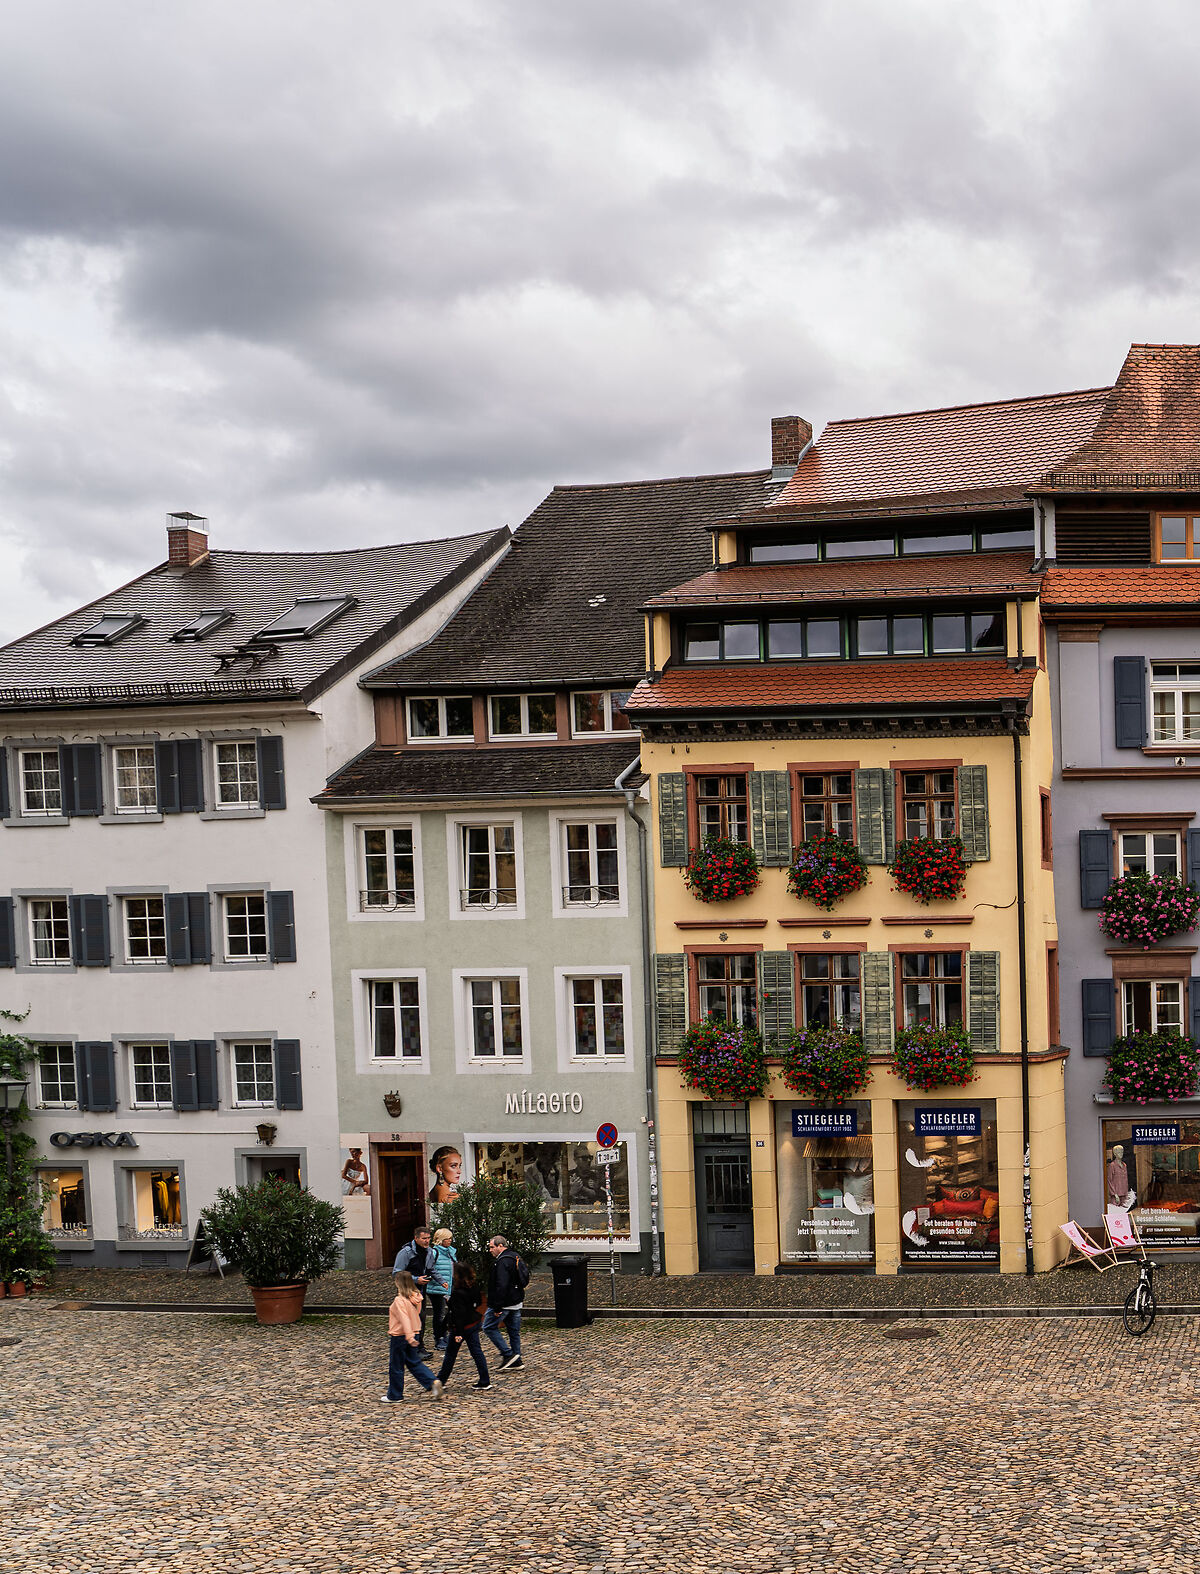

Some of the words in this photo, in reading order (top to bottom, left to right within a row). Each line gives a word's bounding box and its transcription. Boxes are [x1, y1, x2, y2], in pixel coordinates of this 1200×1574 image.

[797, 1114, 852, 1126] STIEGELER
[920, 1113, 976, 1125] STIEGELER
[1135, 1128, 1177, 1137] STIEGELER
[50, 1132, 139, 1148] OSKA
[831, 1219, 856, 1227] Beratung!
[924, 1219, 933, 1227] Gut
[934, 1219, 954, 1227] beraten
[954, 1219, 963, 1227] für
[963, 1219, 977, 1227] Ihren
[797, 1228, 809, 1236] Jetzt
